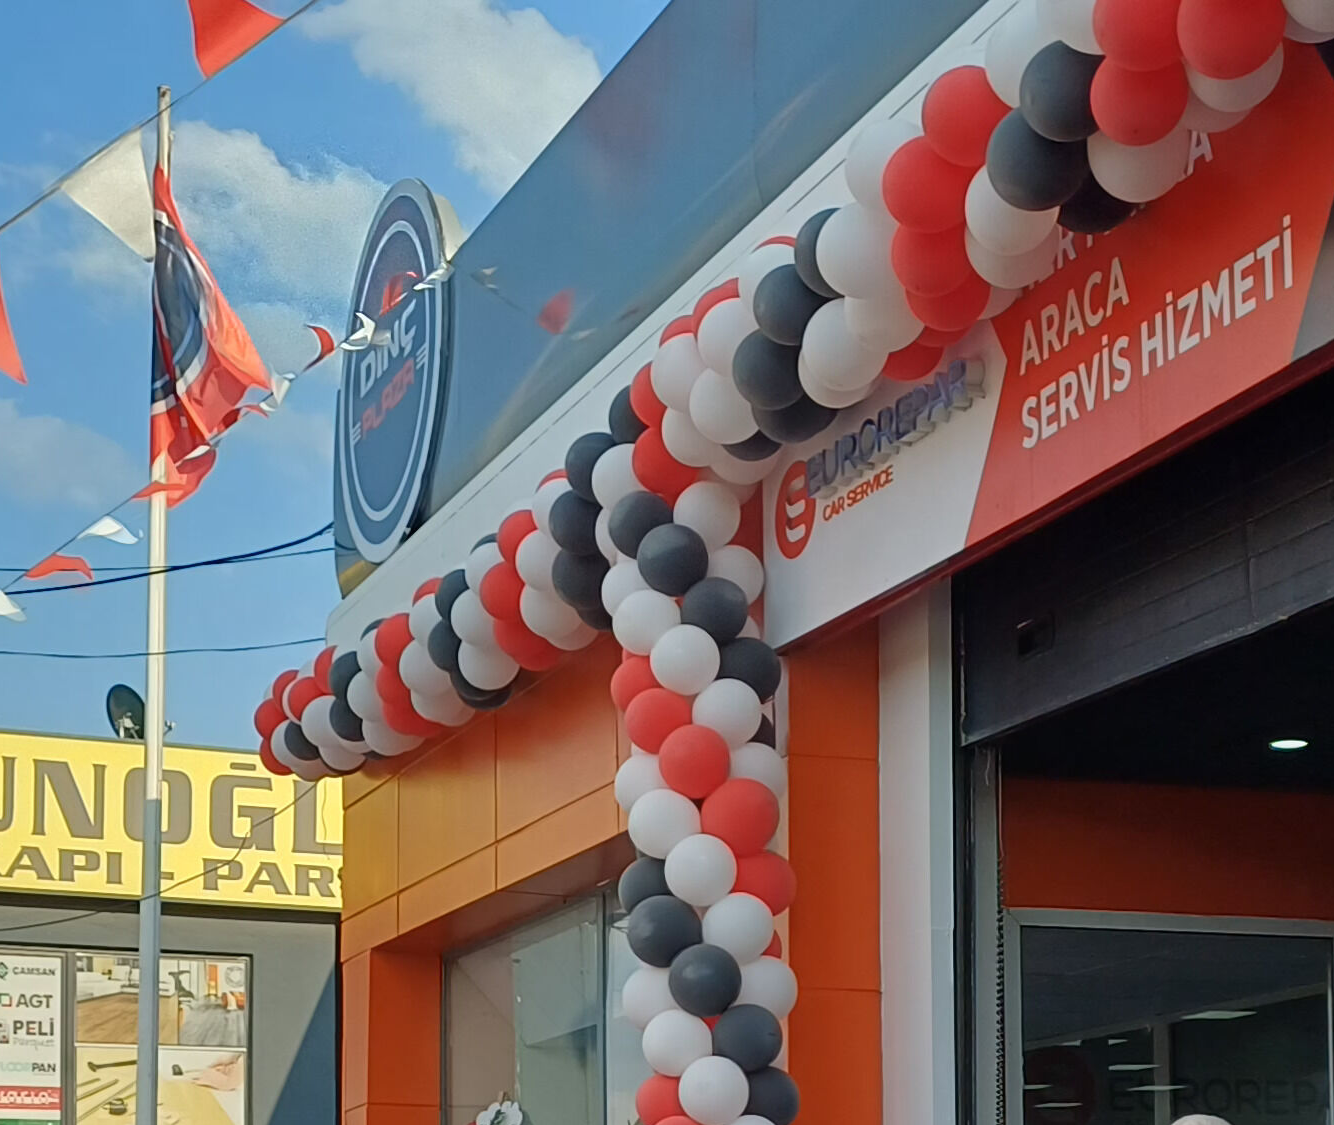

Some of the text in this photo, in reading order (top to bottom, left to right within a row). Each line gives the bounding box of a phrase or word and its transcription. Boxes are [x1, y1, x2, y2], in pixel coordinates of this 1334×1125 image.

[1019, 257, 1130, 376] ARACA
[1021, 335, 1132, 449] SERVİS
[1140, 214, 1294, 377] HİZMETİ
[805, 359, 975, 498] EUROREPAR
[822, 464, 895, 522] CAR SERVICE
[202, 857, 342, 898] PAR
[12, 1018, 55, 1037] PELİ
[15, 993, 54, 1008] AGT
